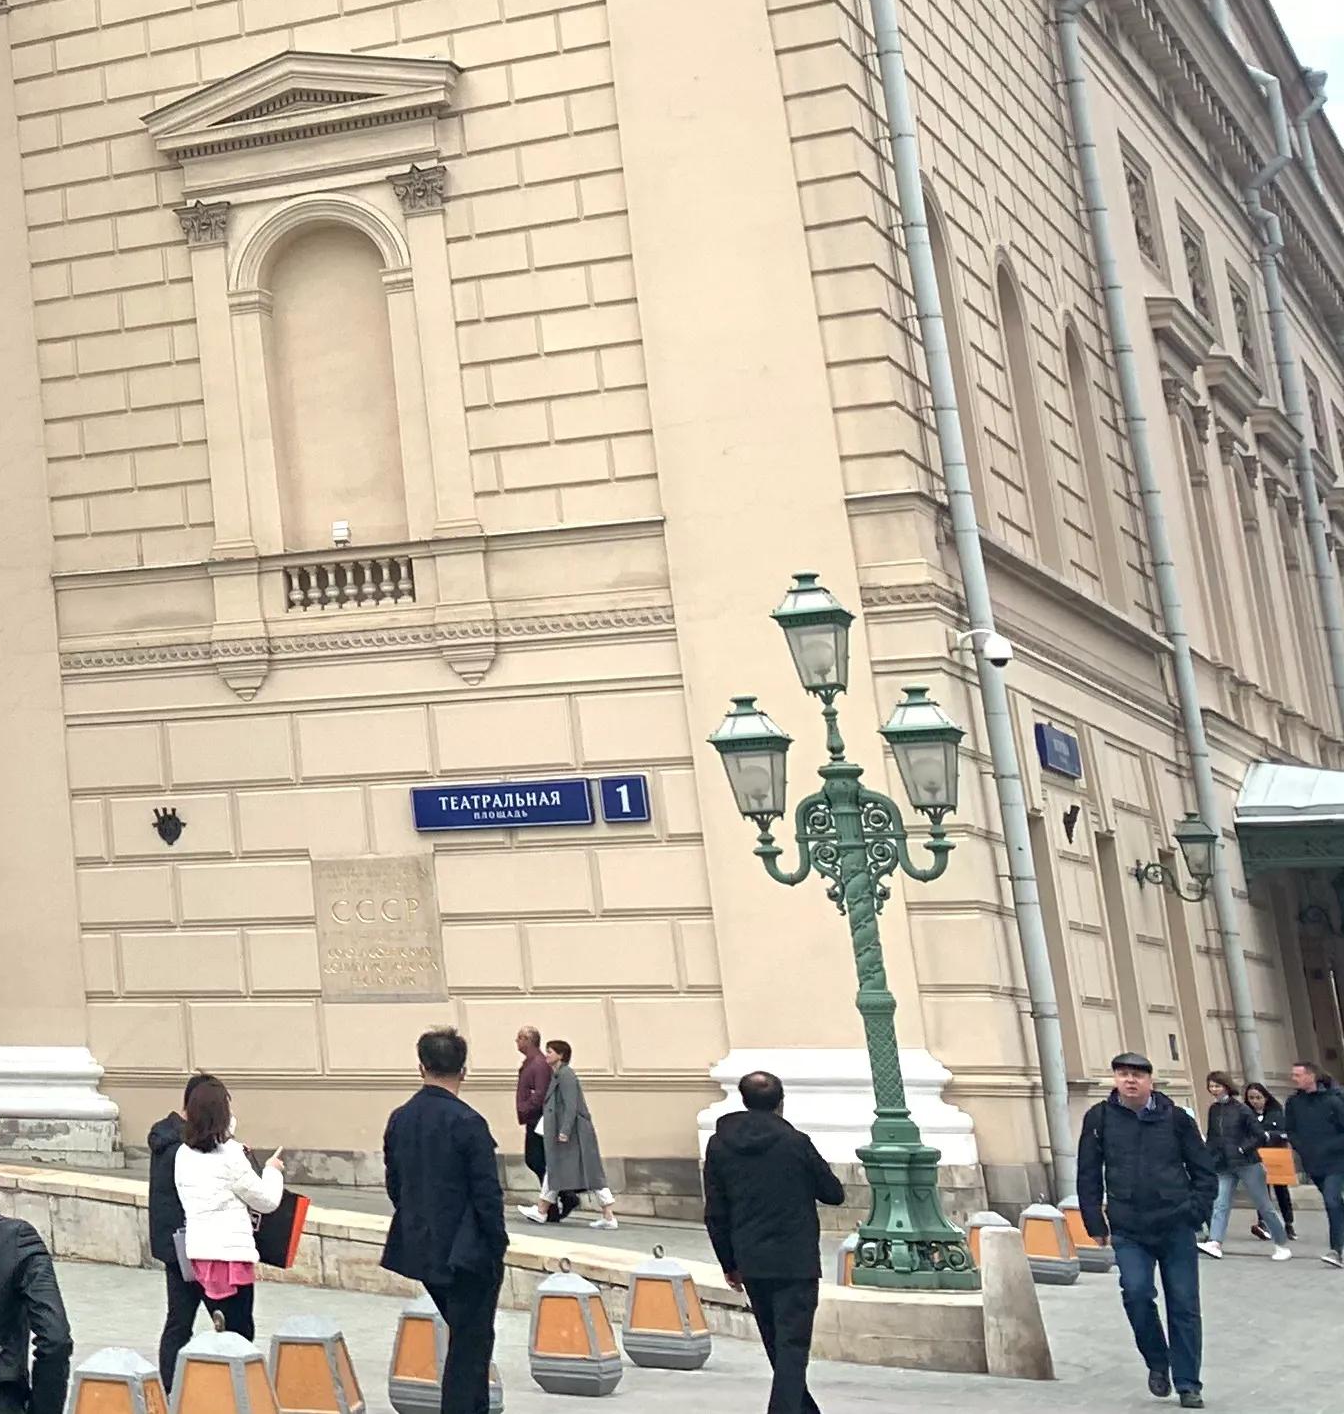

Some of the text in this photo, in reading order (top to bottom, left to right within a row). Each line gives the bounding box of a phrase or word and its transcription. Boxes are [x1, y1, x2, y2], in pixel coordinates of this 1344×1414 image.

[439, 791, 561, 810] ТЕАТРАЛЬНАЯ
[616, 784, 631, 813] 1
[473, 810, 529, 820] ПЛОЩАДЬ
[331, 897, 419, 924] СССР
